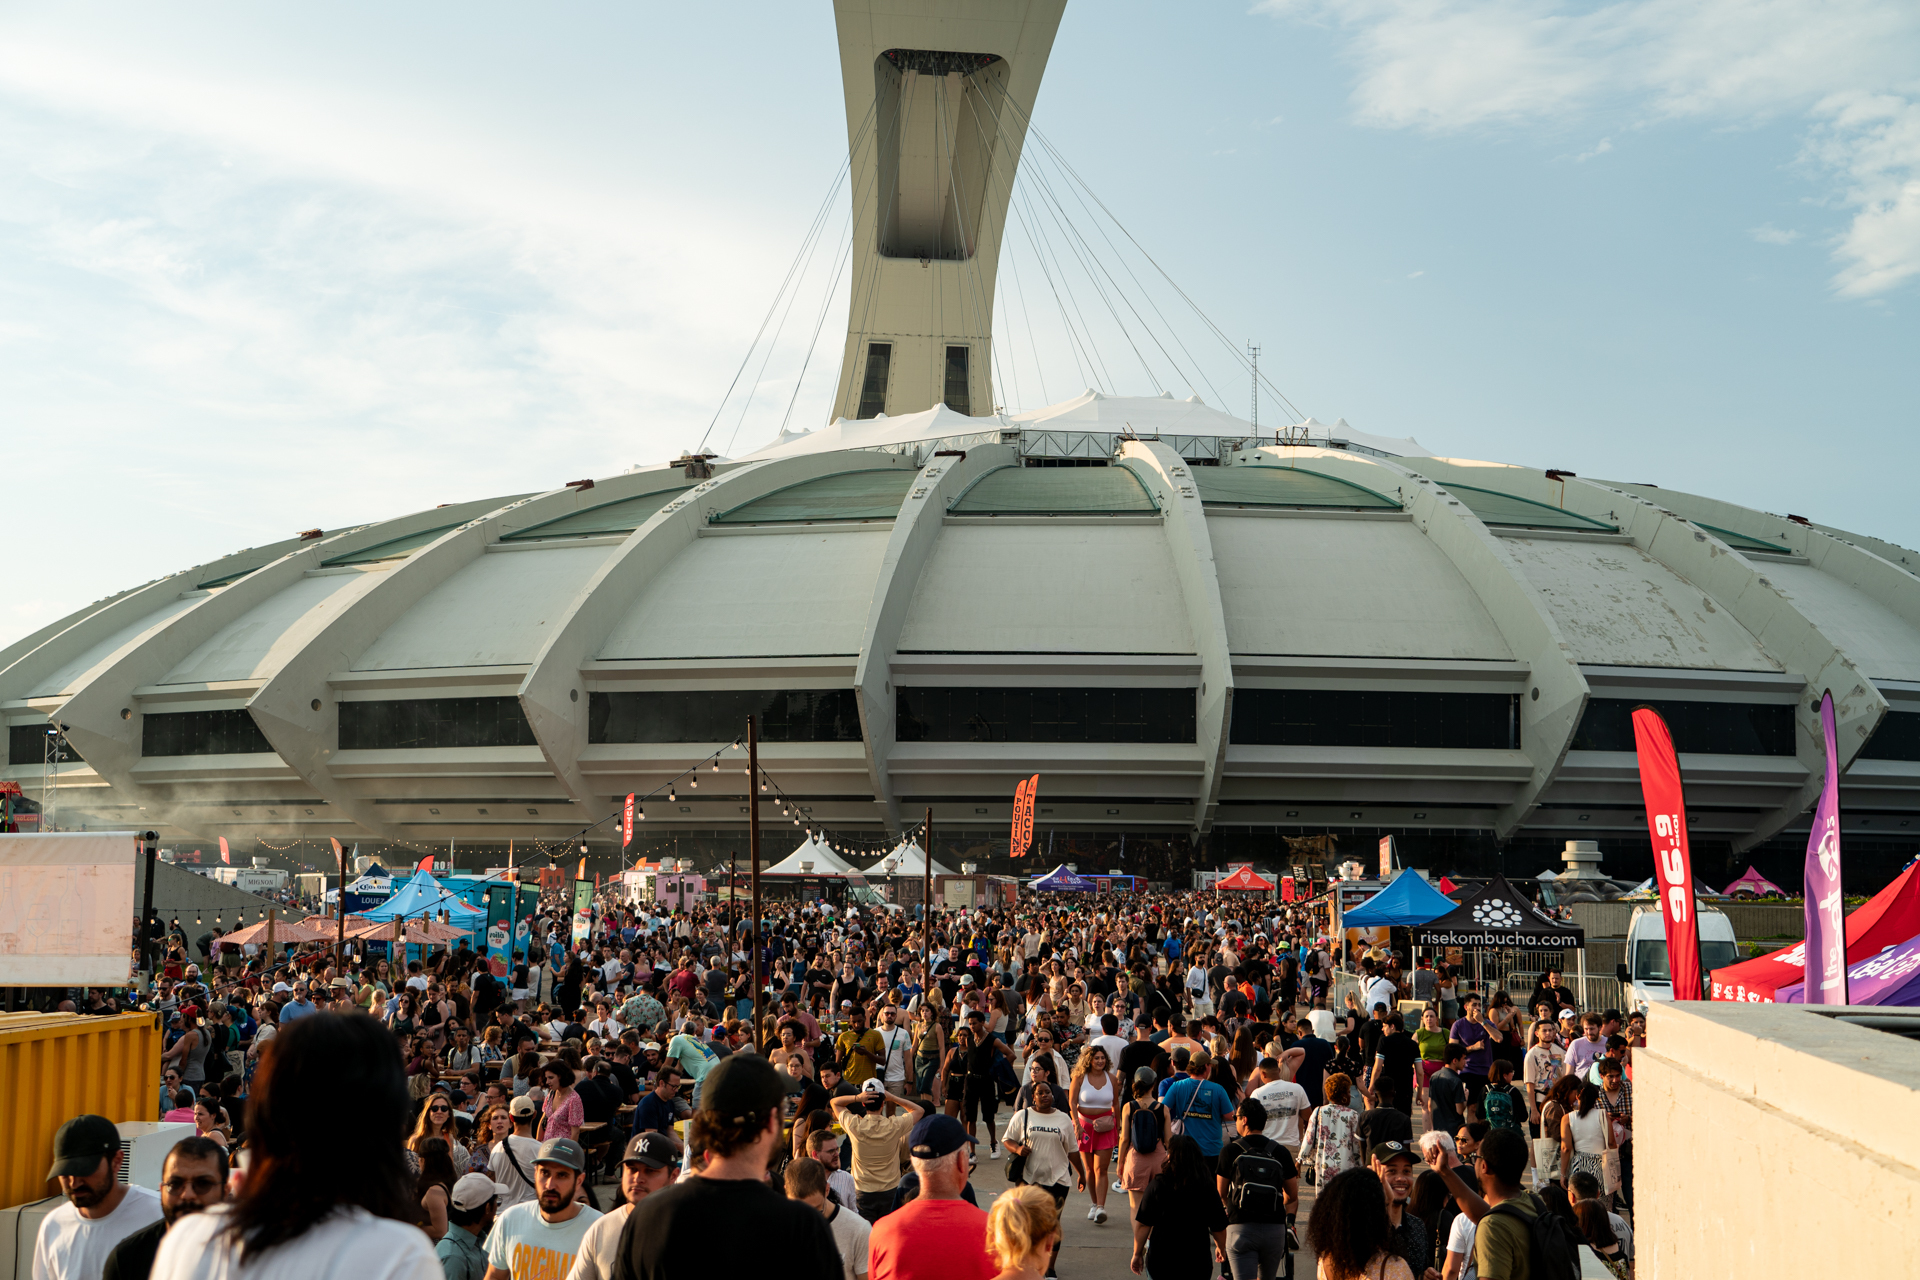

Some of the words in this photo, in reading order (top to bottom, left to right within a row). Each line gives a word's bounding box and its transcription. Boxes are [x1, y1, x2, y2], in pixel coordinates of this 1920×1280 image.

[1012, 797, 1022, 853] POUTINE
[1022, 793, 1033, 853] TACOS
[1654, 814, 1687, 923] 96.9
[361, 897, 385, 905] LOUEZ
[1420, 930, 1577, 946] risekombucha.com
